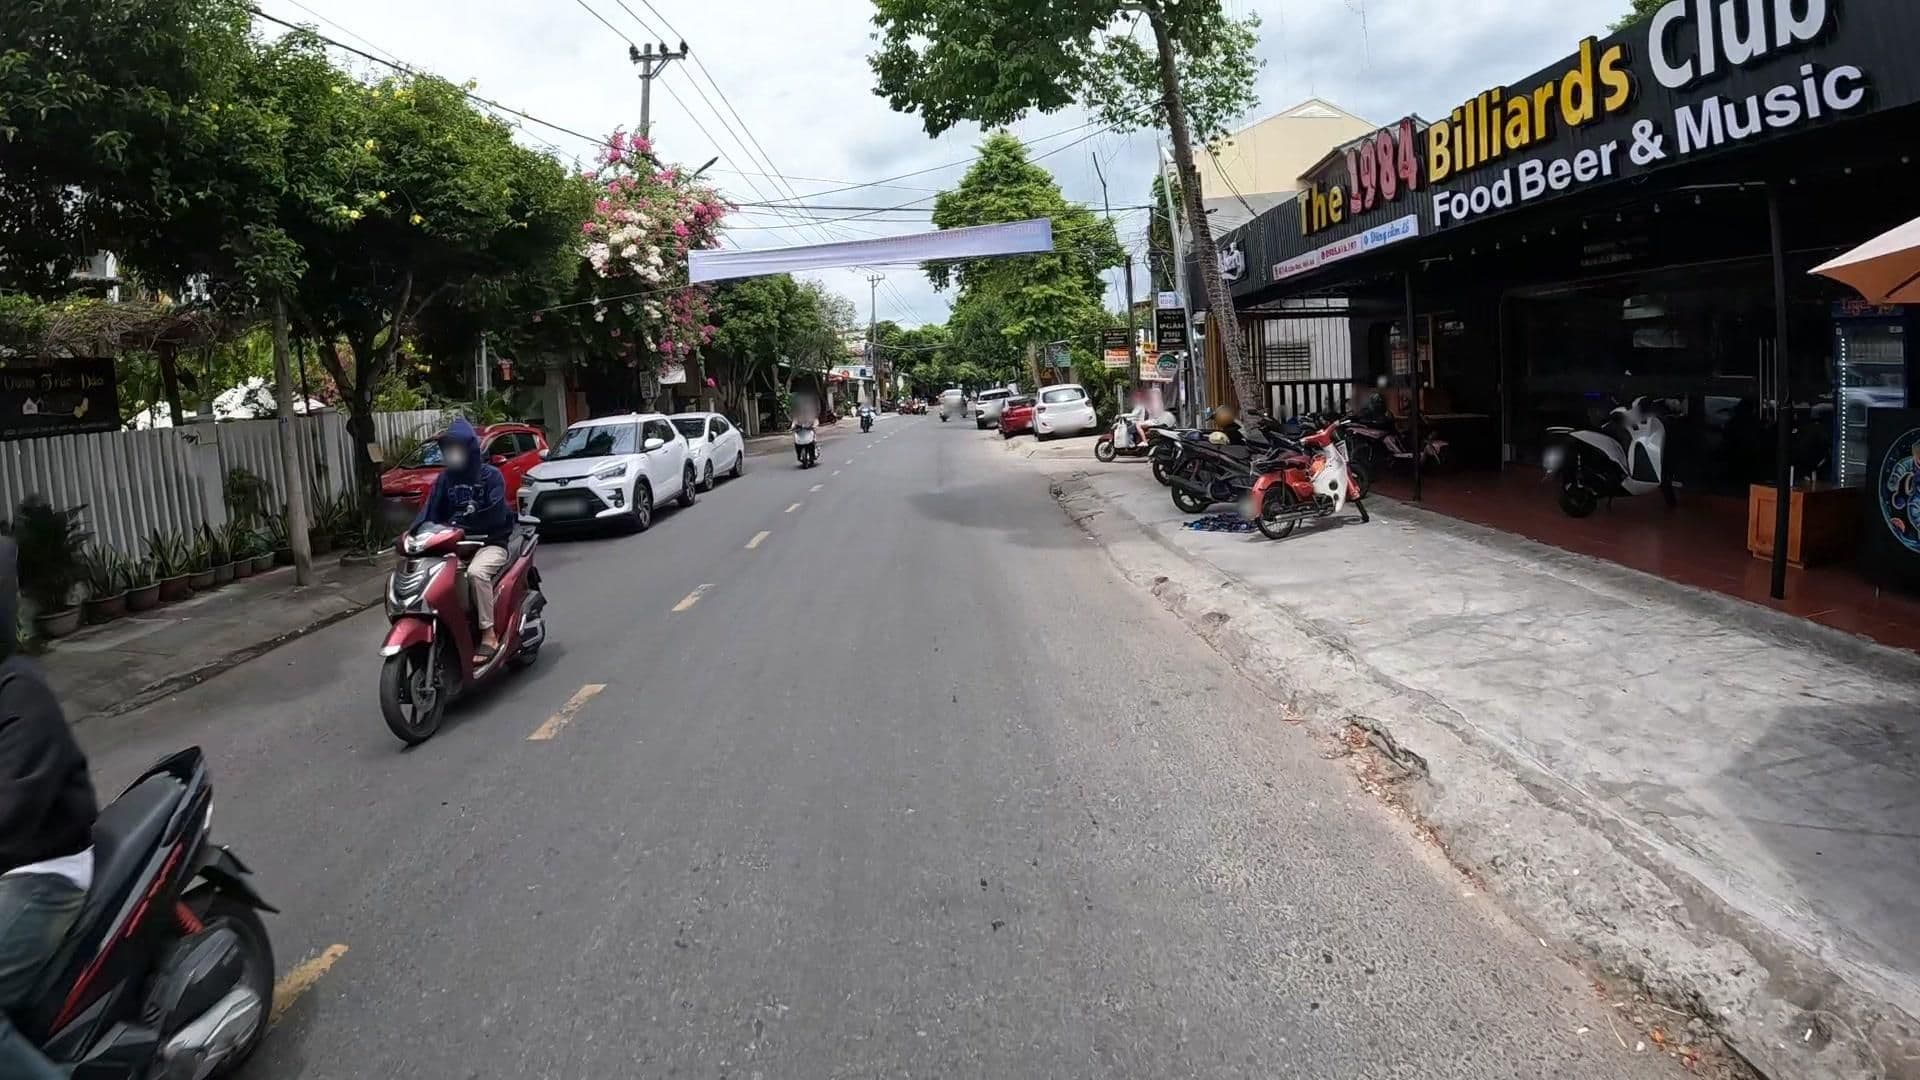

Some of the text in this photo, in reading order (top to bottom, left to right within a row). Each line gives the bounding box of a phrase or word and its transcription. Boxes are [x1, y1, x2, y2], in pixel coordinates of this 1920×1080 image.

[1297, 0, 1826, 235] The 1984 Billiards Club
[1432, 63, 1865, 227] Food Beer & Music
